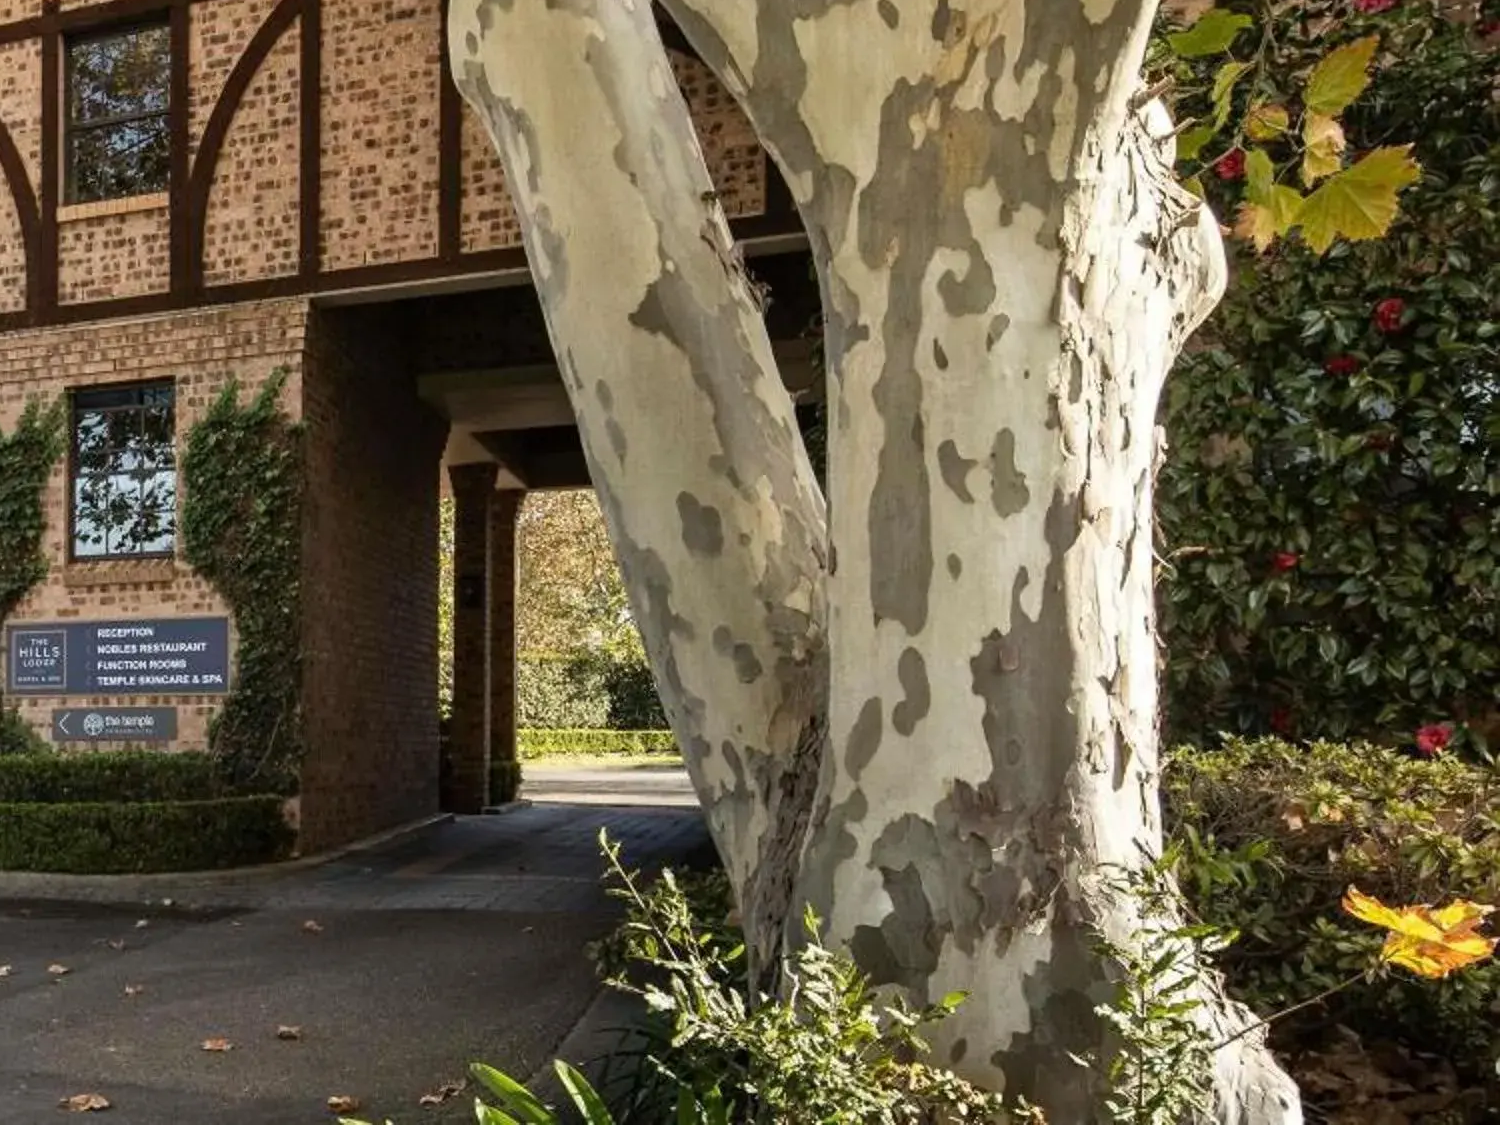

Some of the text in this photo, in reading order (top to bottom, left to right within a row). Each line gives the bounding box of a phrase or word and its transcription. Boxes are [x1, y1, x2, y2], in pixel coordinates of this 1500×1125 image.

[97, 628, 154, 638] RECEPTION
[31, 638, 48, 646] THE
[19, 646, 60, 657] HILLS
[97, 642, 207, 654] NOBLES RESTAURANT
[97, 658, 187, 670] FUNCTION ROOMS
[96, 675, 223, 686] TEMPLE SKINCARE & SPA
[105, 715, 155, 728] the temple
